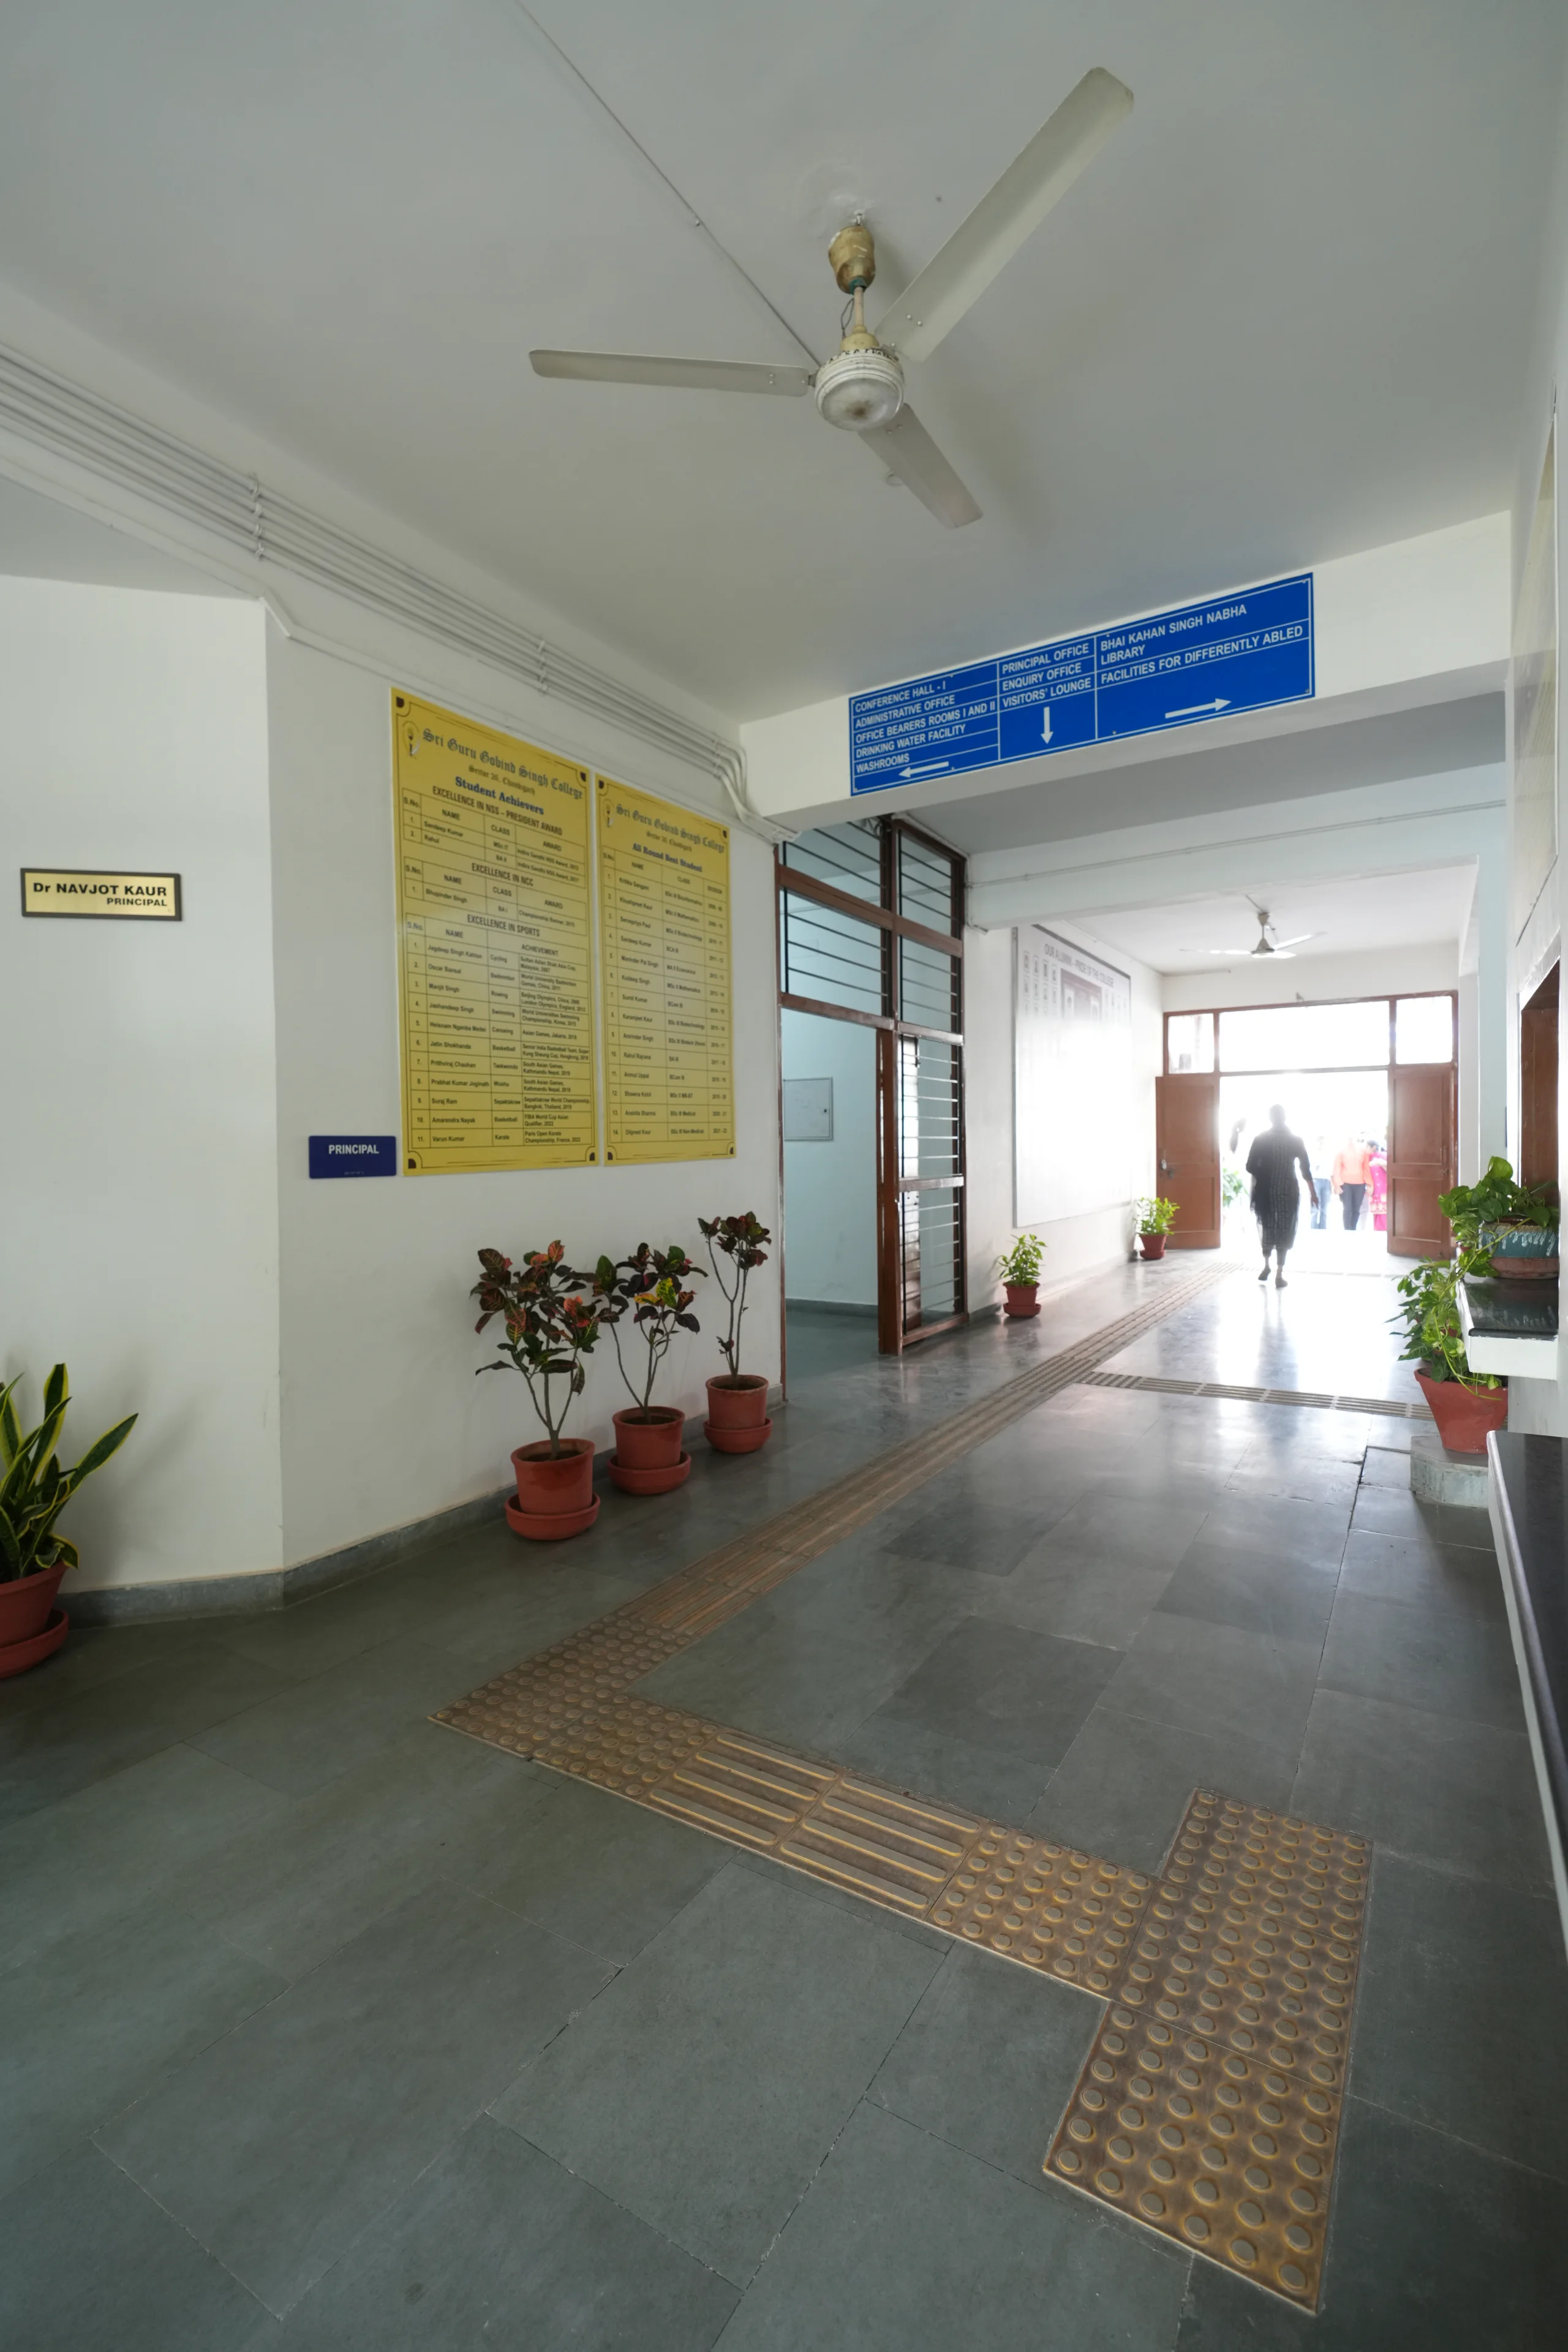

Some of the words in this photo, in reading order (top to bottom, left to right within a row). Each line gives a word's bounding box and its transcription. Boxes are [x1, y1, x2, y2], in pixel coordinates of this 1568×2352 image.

[1101, 635, 1125, 652] BHAI
[1128, 625, 1165, 644] KAHAN
[1169, 614, 1202, 634] SINGH
[1206, 603, 1246, 624] NABHA
[1002, 653, 1050, 674] PRINCIPAL
[1054, 643, 1088, 661] OFFICE
[1101, 661, 1155, 684] FACILITIES
[1159, 655, 1180, 670] FOR
[1185, 635, 1259, 664] DIFFERENTLY
[1262, 625, 1302, 645] ABLED
[1101, 644, 1145, 665] LIBRARY
[1003, 672, 1043, 691] ENQUIRY
[1046, 662, 1080, 680] OFFICE
[855, 690, 910, 713] CONFERENCE
[912, 684, 933, 698] HALL
[943, 680, 945, 690] I
[1003, 688, 1048, 708] VISITORS'
[1050, 677, 1090, 696] LOUNGE
[855, 703, 921, 728] ADMINISTRATIVE
[924, 695, 955, 710] OFFICE
[856, 728, 884, 744] OFFICE
[886, 718, 925, 736] BEARERS
[929, 709, 960, 726] ROOMS
[963, 708, 965, 717] I
[968, 703, 987, 716] AND
[990, 701, 995, 711] II
[856, 741, 894, 758] DRINKING
[897, 733, 925, 748] WATER
[928, 724, 965, 741] FACILITY
[422, 728, 443, 747] Sri
[447, 737, 475, 759] Guru
[480, 750, 514, 774] Gobind
[518, 765, 548, 788] Singh
[551, 778, 582, 801] College
[856, 753, 909, 773] WASHROOMS
[455, 775, 496, 799] Student
[499, 791, 544, 815] Achievers
[432, 785, 475, 807] EXCELLENCE
[477, 800, 484, 810] IN
[486, 803, 499, 815] NSS
[506, 810, 539, 828] PRESIDENT
[541, 821, 562, 836] AWARD
[424, 821, 445, 833] Sandeep
[447, 827, 463, 837] Kumar
[442, 809, 460, 820] NAME
[491, 824, 510, 835] CLASS
[543, 840, 561, 851] AWARD
[632, 842, 641, 853] All
[643, 846, 663, 860] Round
[665, 853, 678, 864] Best
[680, 858, 702, 872] Student
[472, 862, 510, 881] EXCELLENCE
[512, 873, 518, 883] IN
[520, 875, 533, 887] NCC
[677, 875, 690, 884] CLASS
[34, 883, 50, 892] Dr
[56, 883, 119, 894] NAVJOT
[124, 886, 167, 896] KAUR
[107, 898, 167, 907] PRINCIPAL
[444, 873, 461, 884] NAME
[492, 886, 511, 897] CLASS
[544, 899, 563, 909] AWARD
[453, 895, 467, 905] Singh
[467, 914, 506, 930] EXCELLENCE
[508, 923, 515, 932] IN
[517, 925, 540, 937] SPORTS
[445, 929, 463, 938] NAME
[521, 943, 558, 956] ACHIEVEMENT
[450, 948, 463, 957] Singh
[490, 954, 507, 963] Cycling
[445, 985, 459, 993] Singh
[328, 1144, 380, 1154] PRINCIPAL
